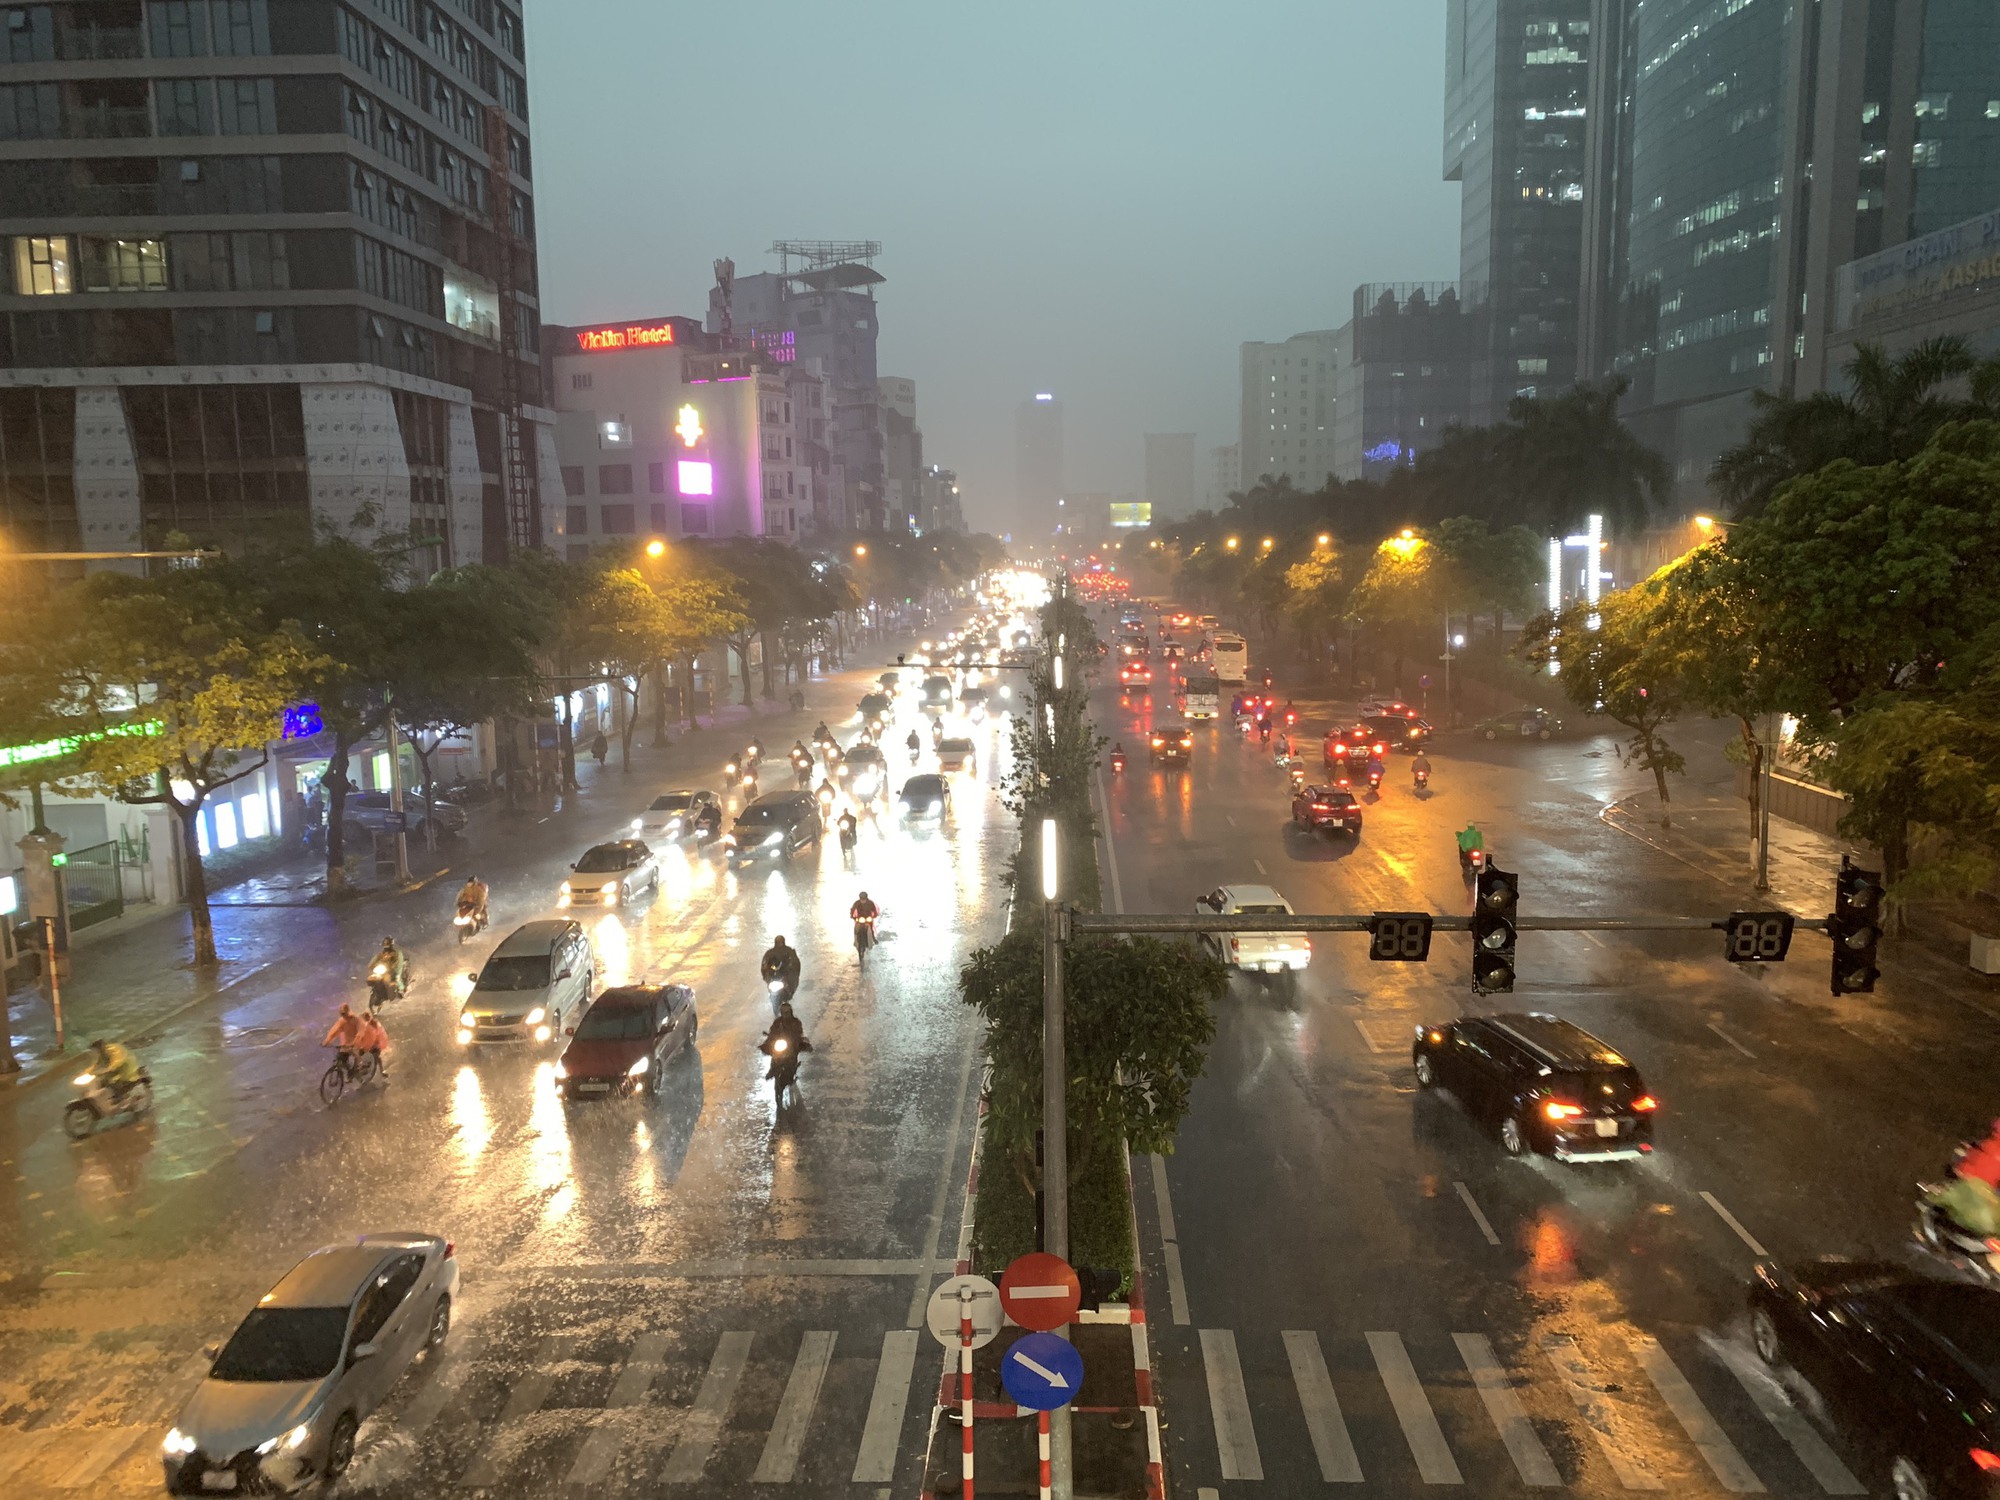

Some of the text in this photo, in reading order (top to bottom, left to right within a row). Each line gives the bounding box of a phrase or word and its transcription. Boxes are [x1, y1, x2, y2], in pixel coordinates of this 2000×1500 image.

[577, 323, 673, 349] Violin Hotel
[1377, 919, 1424, 956] 88
[1735, 920, 1782, 956] 88
